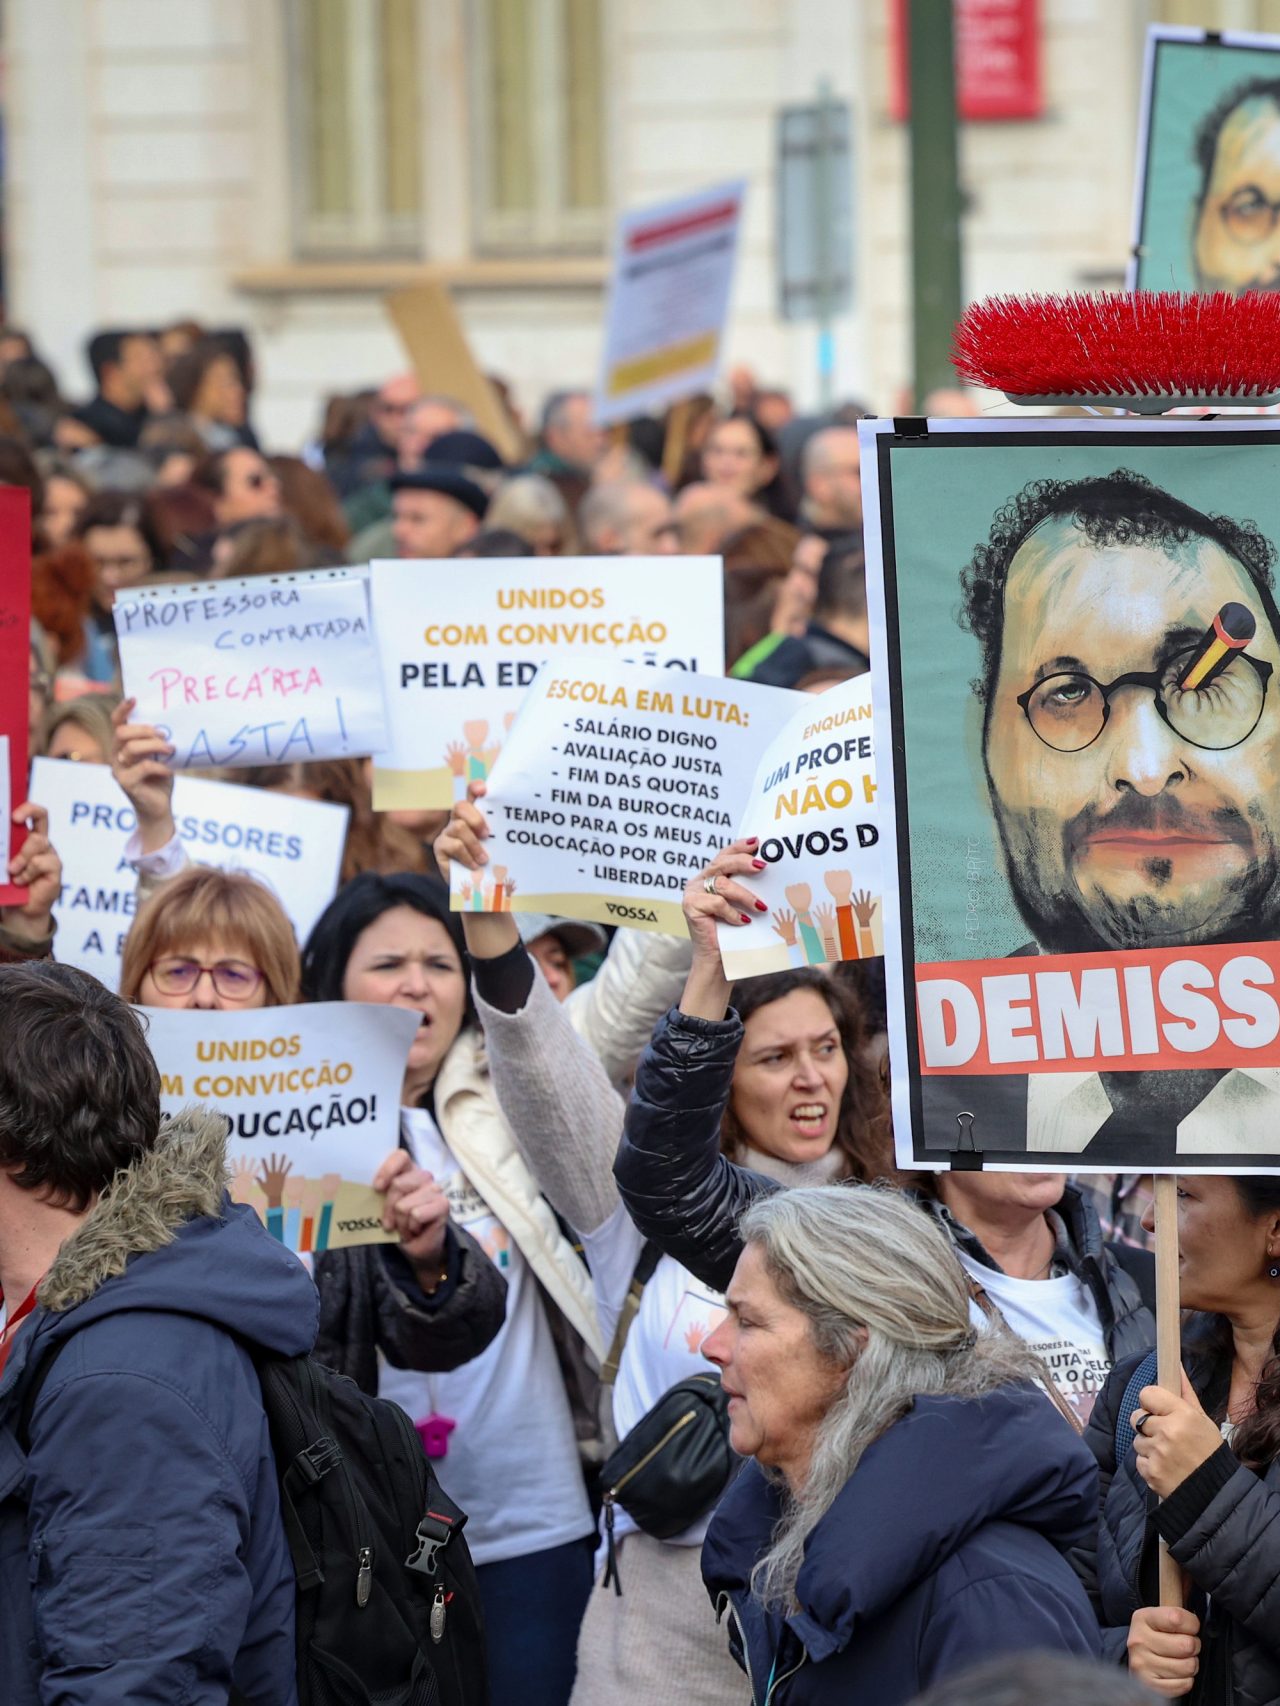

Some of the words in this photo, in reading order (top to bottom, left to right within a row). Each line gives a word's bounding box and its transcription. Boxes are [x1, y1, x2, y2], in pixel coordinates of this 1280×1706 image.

[124, 590, 300, 631] PROFESSORA
[497, 588, 605, 609] UNIDOS
[215, 617, 366, 650] CONTRATADA
[425, 624, 488, 646] COM
[498, 616, 667, 648] CONVICÇÃO
[401, 662, 485, 688] PELA
[547, 680, 628, 708] ESCOLA
[636, 690, 673, 714] EM
[682, 696, 750, 727] LUTA:
[575, 717, 651, 741] SALÁRIO
[658, 727, 717, 750] DIGNO
[563, 741, 667, 769] AVALIAÇÃO
[671, 756, 723, 777] JUSTA
[763, 761, 790, 793] UM
[795, 736, 875, 775] PROFE
[568, 767, 598, 784] FIM
[605, 771, 641, 789] DAS
[647, 776, 720, 800] QUOTAS
[775, 776, 853, 820] NÃO
[504, 806, 565, 826] TEMPO
[571, 815, 618, 836] PARA
[624, 822, 648, 838] OS
[654, 825, 702, 846] MEUS
[552, 789, 582, 806] FIM
[588, 793, 612, 810] DA
[619, 798, 732, 828] BUROCRACIA
[506, 829, 615, 858] COLOCAÇÃO
[620, 845, 656, 864] POR
[754, 828, 848, 863] OVOS
[197, 1035, 301, 1062] UNIDOS
[193, 1060, 353, 1098] CONVICÇÃO
